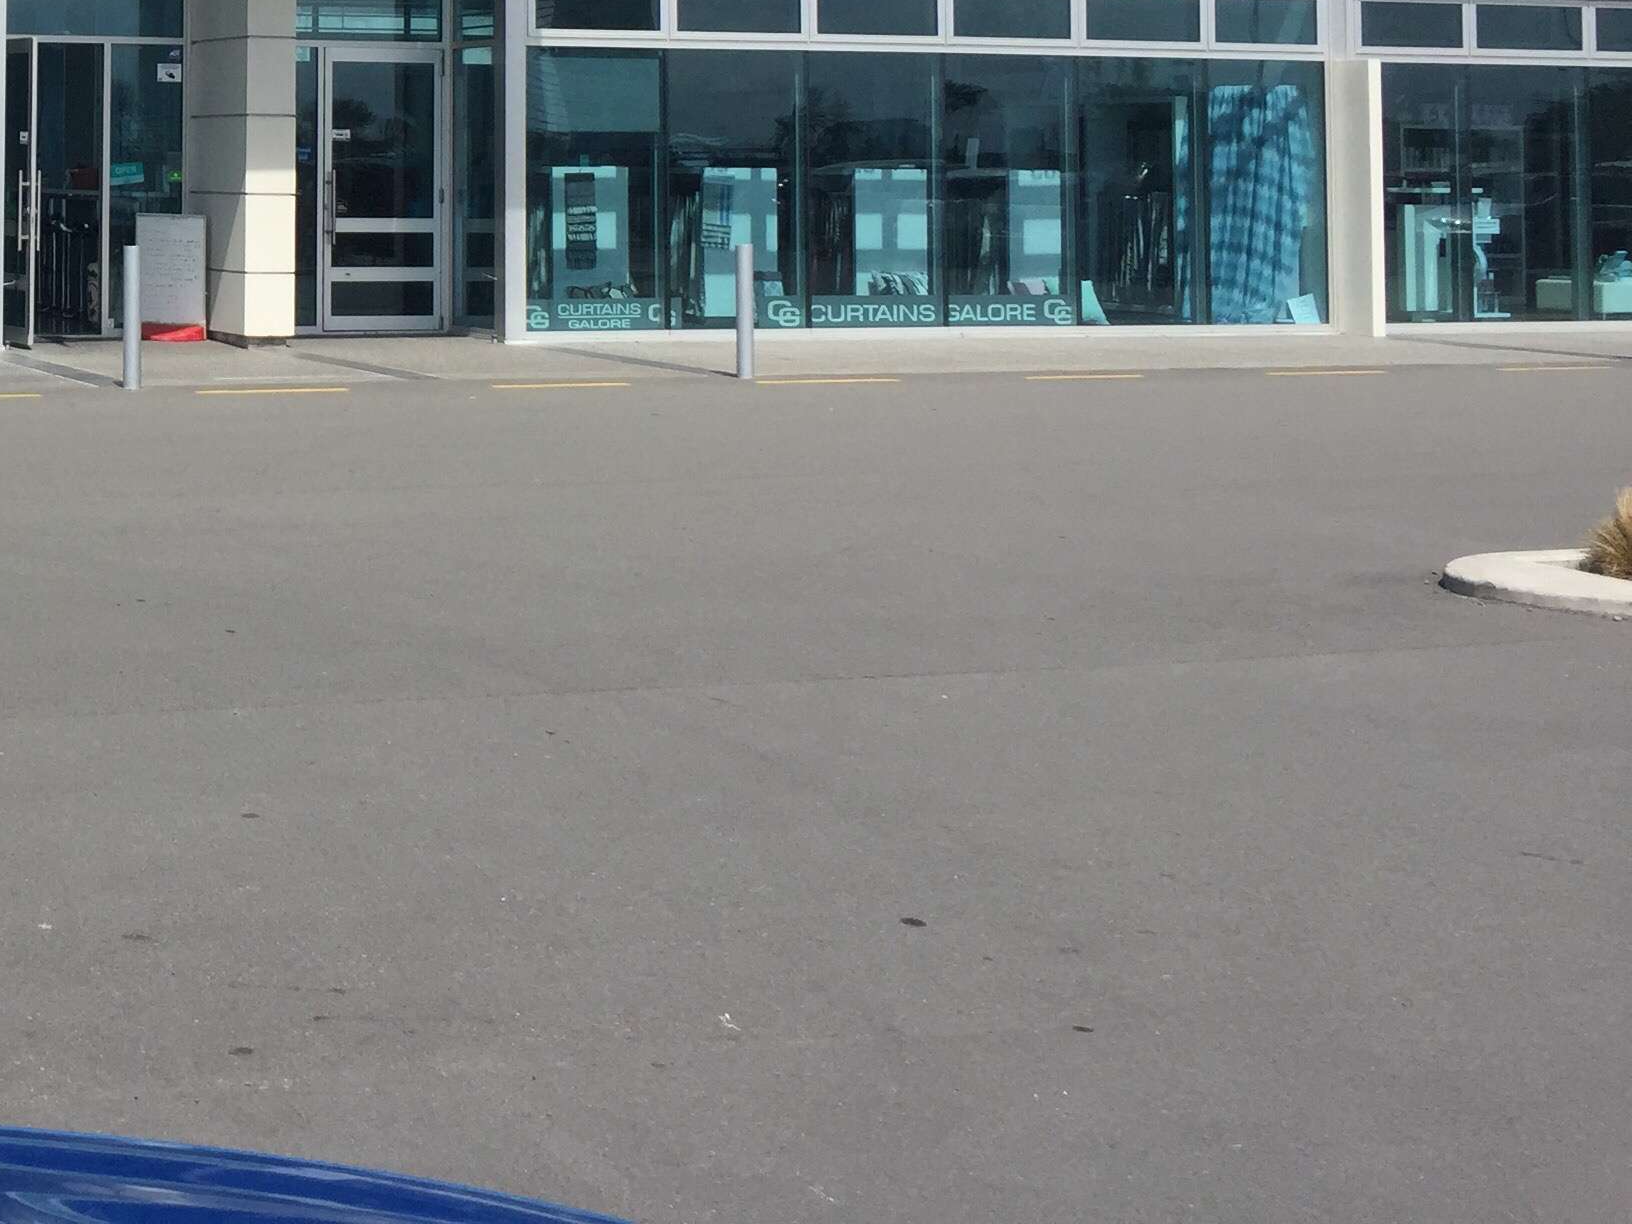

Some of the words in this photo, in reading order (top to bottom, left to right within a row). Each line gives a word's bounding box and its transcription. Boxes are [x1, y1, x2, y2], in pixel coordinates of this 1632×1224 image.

[557, 303, 642, 317] CURTAINS
[811, 304, 936, 324] CURTAINS
[947, 303, 1036, 322] GALORE
[567, 319, 632, 329] GALORE
